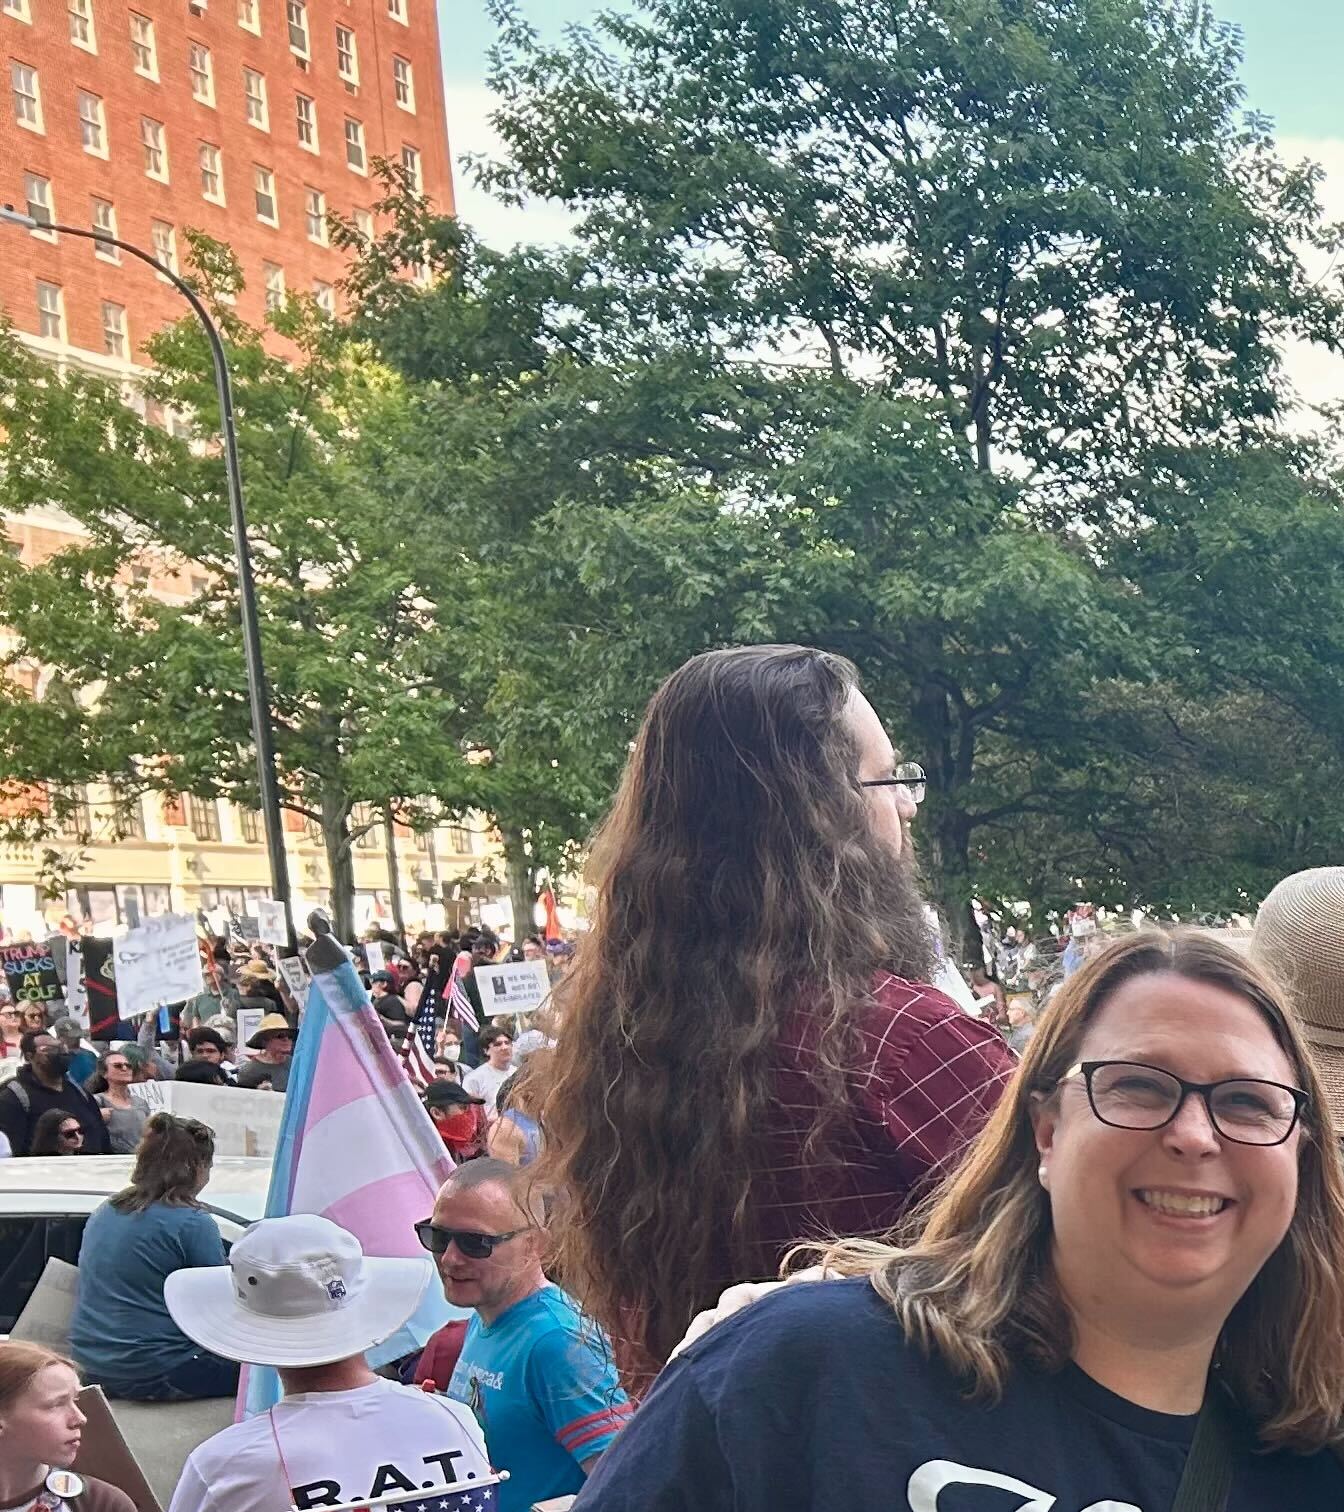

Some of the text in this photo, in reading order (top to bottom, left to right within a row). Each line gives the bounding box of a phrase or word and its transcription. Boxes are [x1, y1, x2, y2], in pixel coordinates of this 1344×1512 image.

[1, 943, 50, 961] TRUMP
[3, 955, 56, 974] SUCKS
[22, 971, 42, 988] AT
[15, 984, 58, 1002] GOLF
